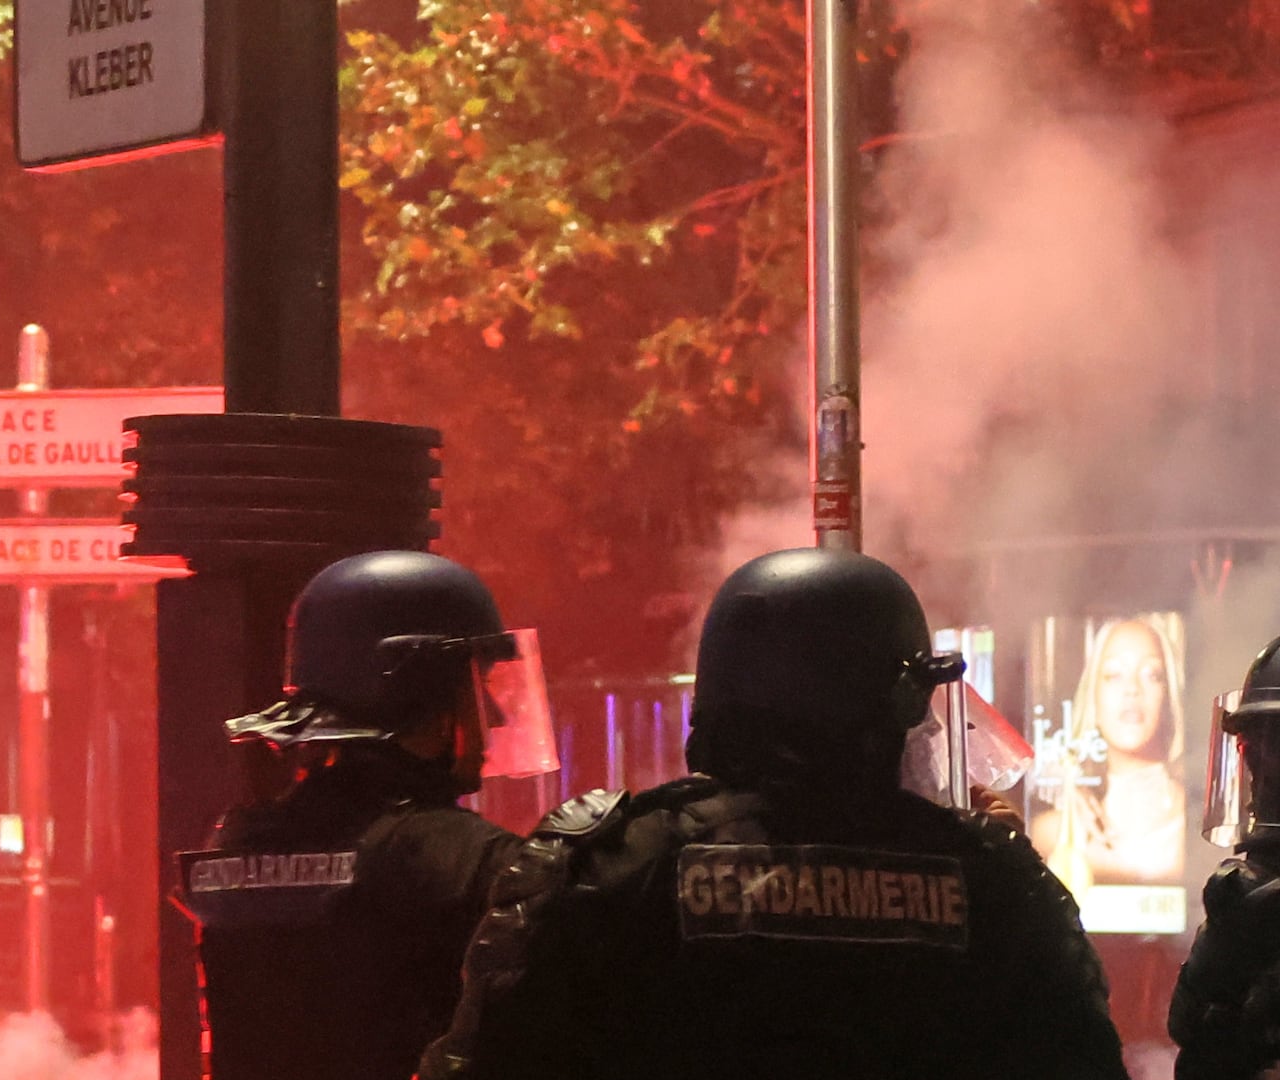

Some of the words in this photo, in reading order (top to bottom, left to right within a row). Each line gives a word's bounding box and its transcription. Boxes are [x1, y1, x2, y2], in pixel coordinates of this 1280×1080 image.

[68, 41, 154, 100] KLEBER
[7, 443, 37, 465] DE
[43, 442, 122, 464] GAULL
[50, 540, 82, 561] DE
[89, 540, 122, 561] CL
[683, 863, 963, 925] GENDARMERIE
